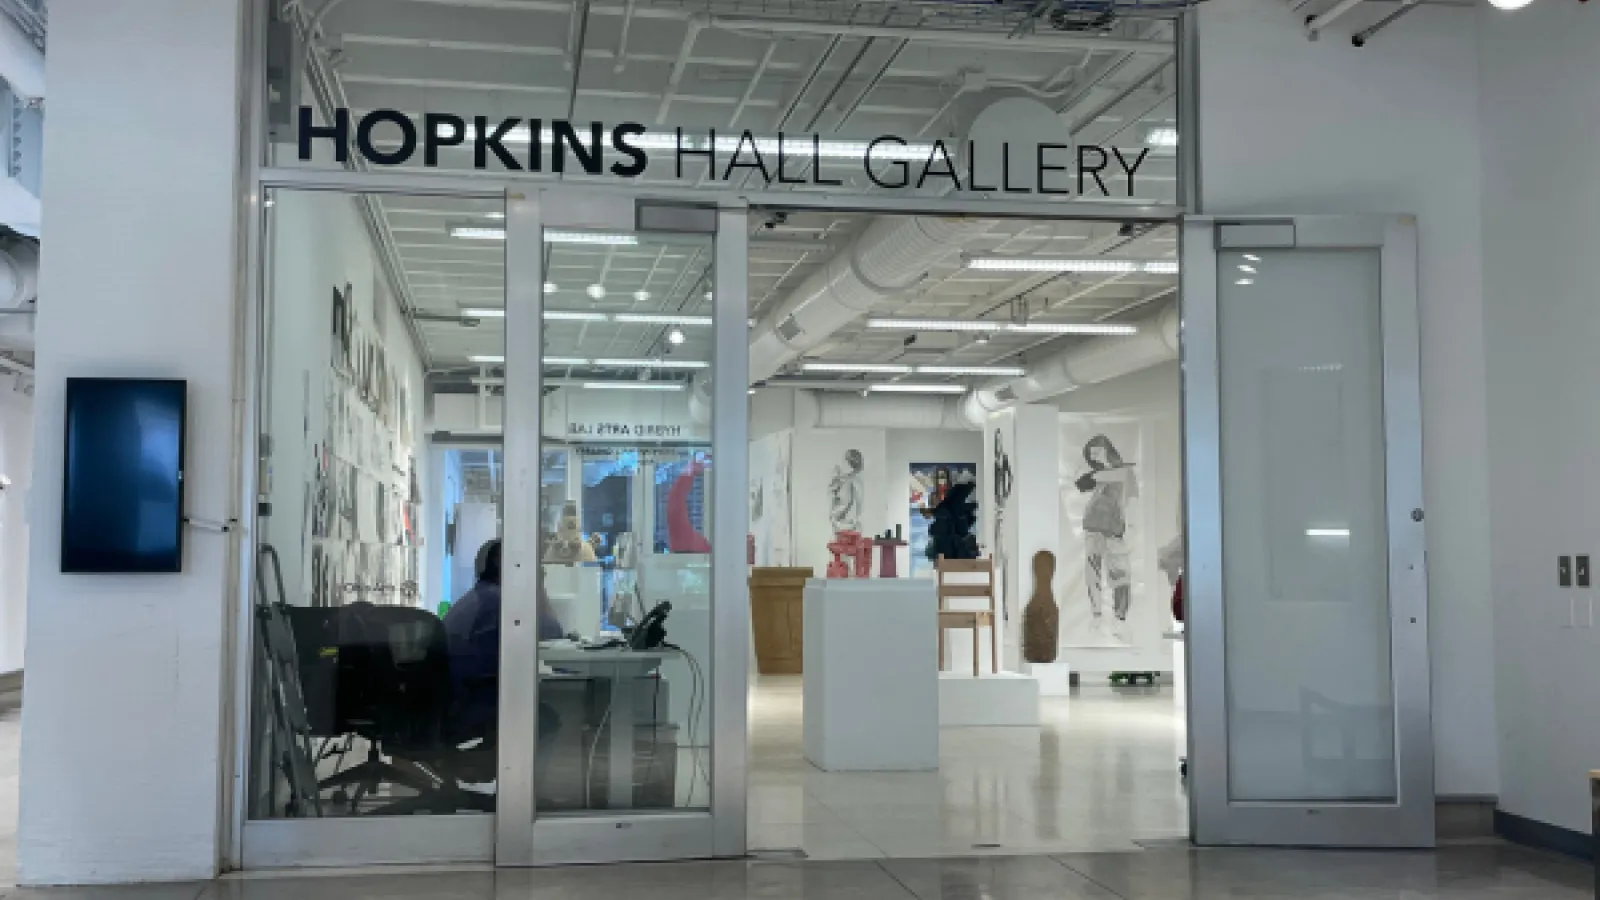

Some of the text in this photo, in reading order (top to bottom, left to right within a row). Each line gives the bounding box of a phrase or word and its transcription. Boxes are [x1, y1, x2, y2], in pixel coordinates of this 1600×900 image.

[298, 106, 1150, 197] HOPKINS HALL GALLERY
